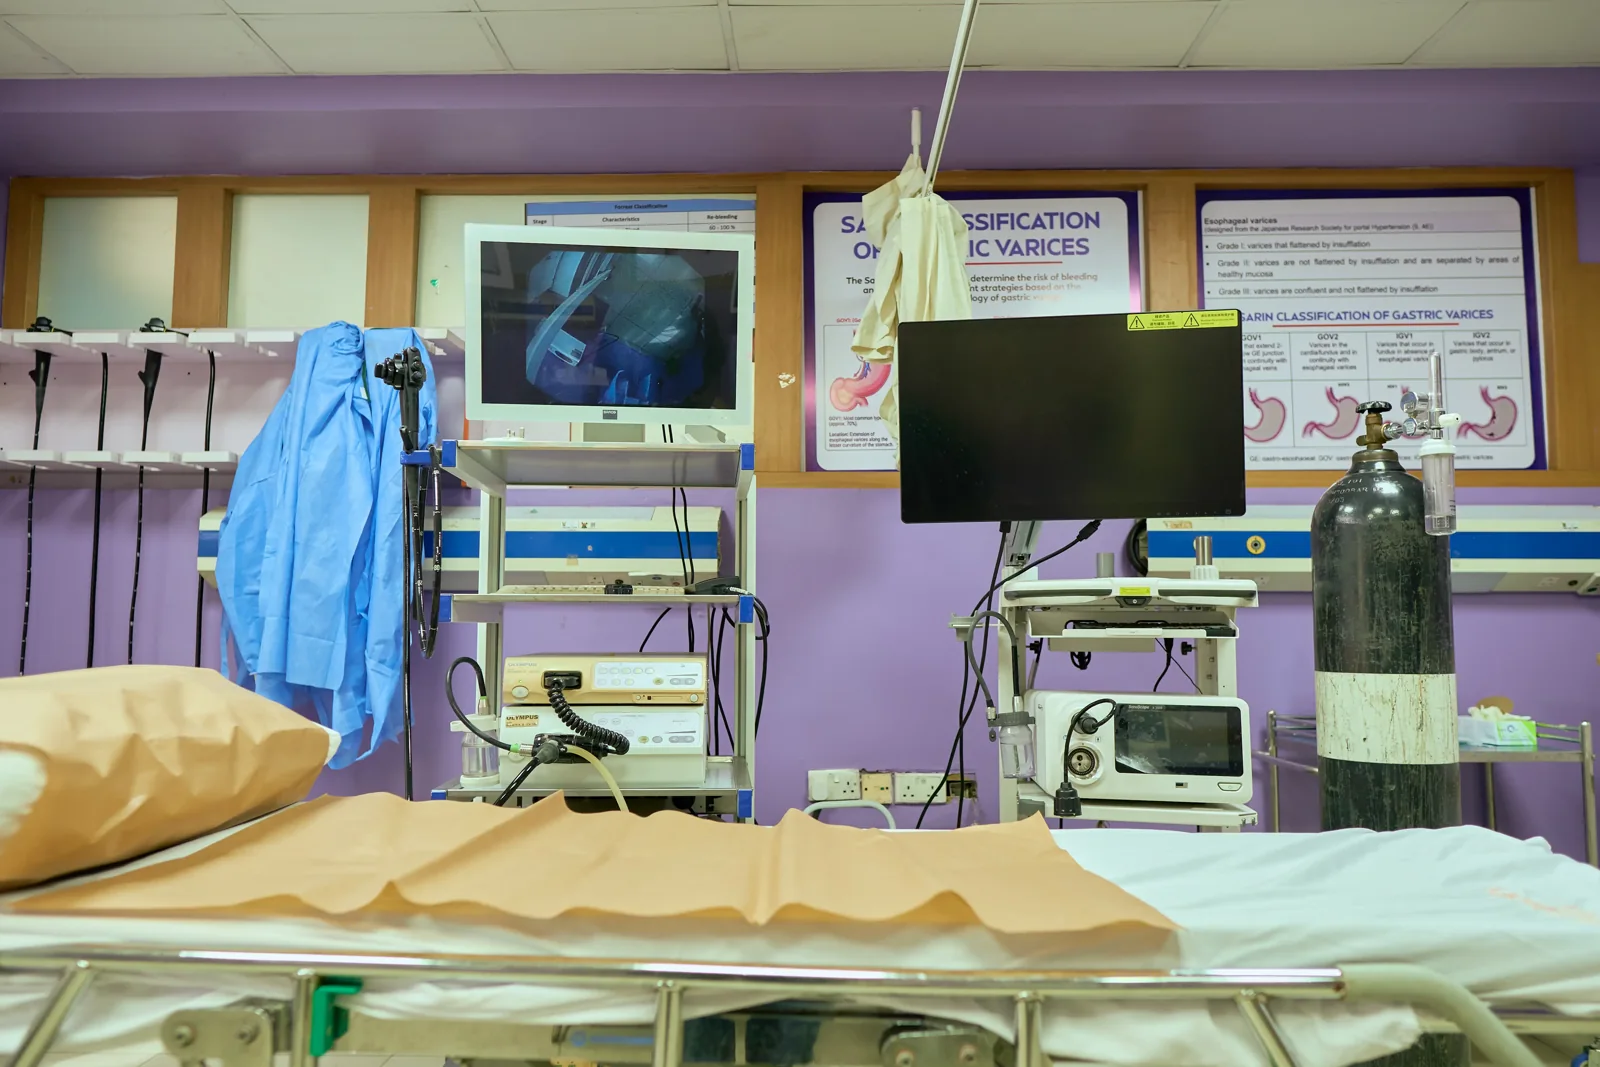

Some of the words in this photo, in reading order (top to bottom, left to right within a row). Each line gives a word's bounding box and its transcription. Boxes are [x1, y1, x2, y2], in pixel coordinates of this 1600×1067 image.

[961, 211, 1100, 231] SSIFICATION
[1204, 217, 1248, 226] Esophageal
[994, 238, 1090, 256] VARICES
[1322, 241, 1331, 250] by
[1348, 258, 1358, 266] by
[1436, 256, 1472, 265] separated
[1476, 256, 1485, 266] by
[970, 274, 1016, 282] determine
[1016, 273, 1032, 282] the
[1033, 272, 1048, 281] risk
[1050, 272, 1060, 280] of
[1061, 272, 1098, 282] bleeding
[1218, 270, 1243, 278] healthy
[846, 276, 862, 284] The
[980, 283, 1024, 293] strategies
[1026, 282, 1052, 292] based
[1390, 286, 1398, 295] by
[990, 294, 1000, 302] of
[1001, 294, 1030, 303] gastric
[1242, 312, 1274, 322] SARIN
[1276, 310, 1370, 321] CLASSIFICATION
[1373, 310, 1390, 320] OF
[1392, 310, 1443, 320] GASTRIC
[1446, 309, 1494, 319] VARICES
